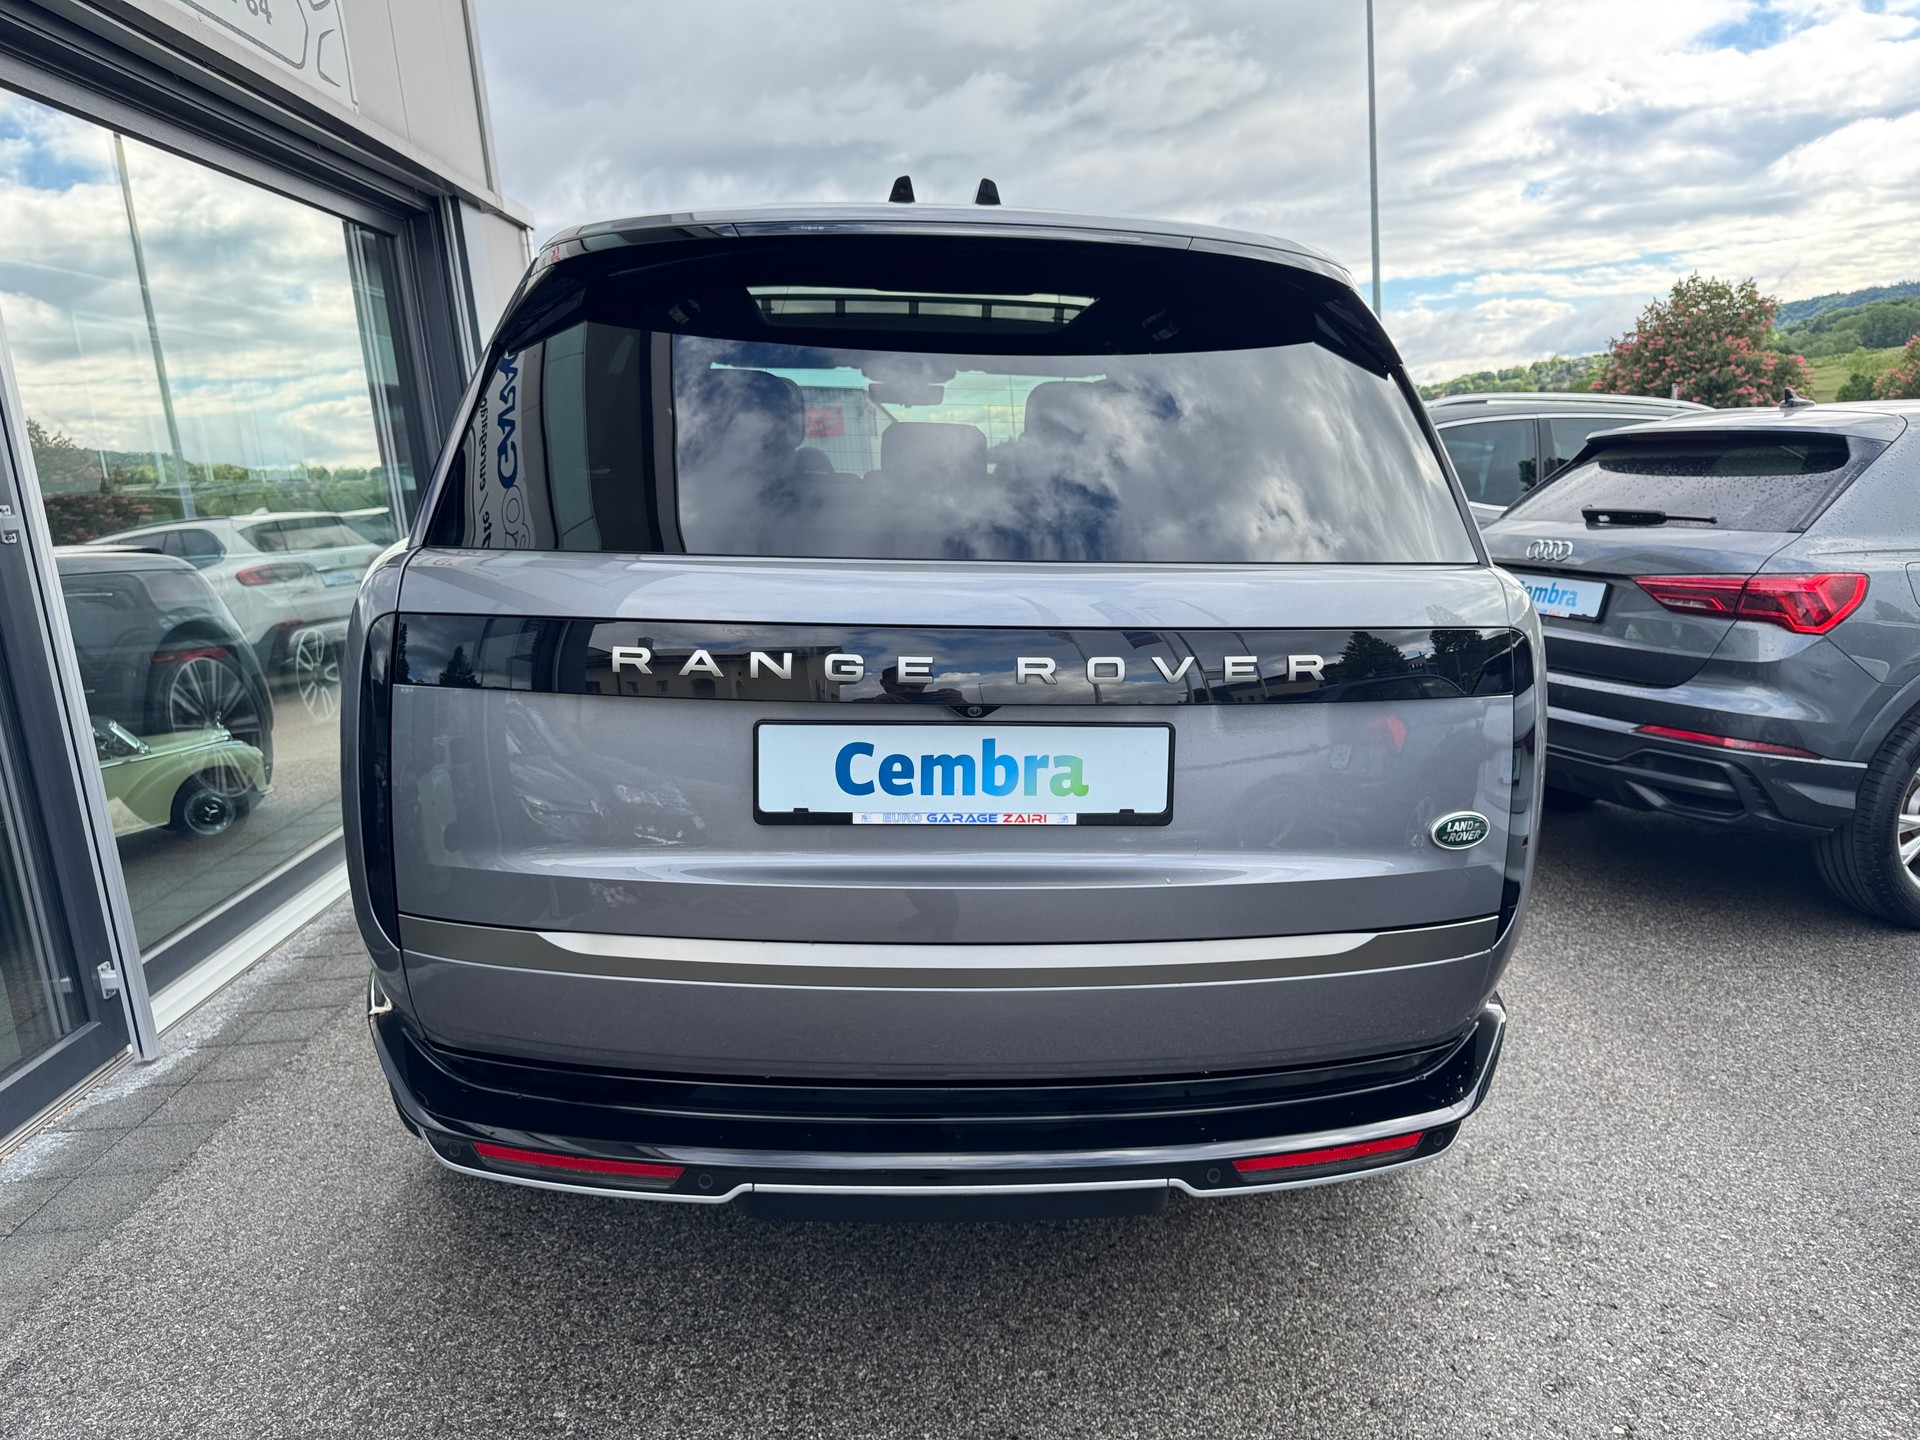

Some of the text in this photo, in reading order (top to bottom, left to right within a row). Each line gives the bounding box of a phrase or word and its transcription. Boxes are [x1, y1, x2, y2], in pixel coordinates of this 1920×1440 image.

[1520, 581, 1578, 607] embra
[611, 645, 1326, 684] RANGE ROVER
[835, 738, 1089, 797] Cembra
[882, 812, 1047, 823] EURO GARAGE ZAIRI
[1446, 821, 1474, 833] LAND
[1447, 830, 1481, 842] ROVER
